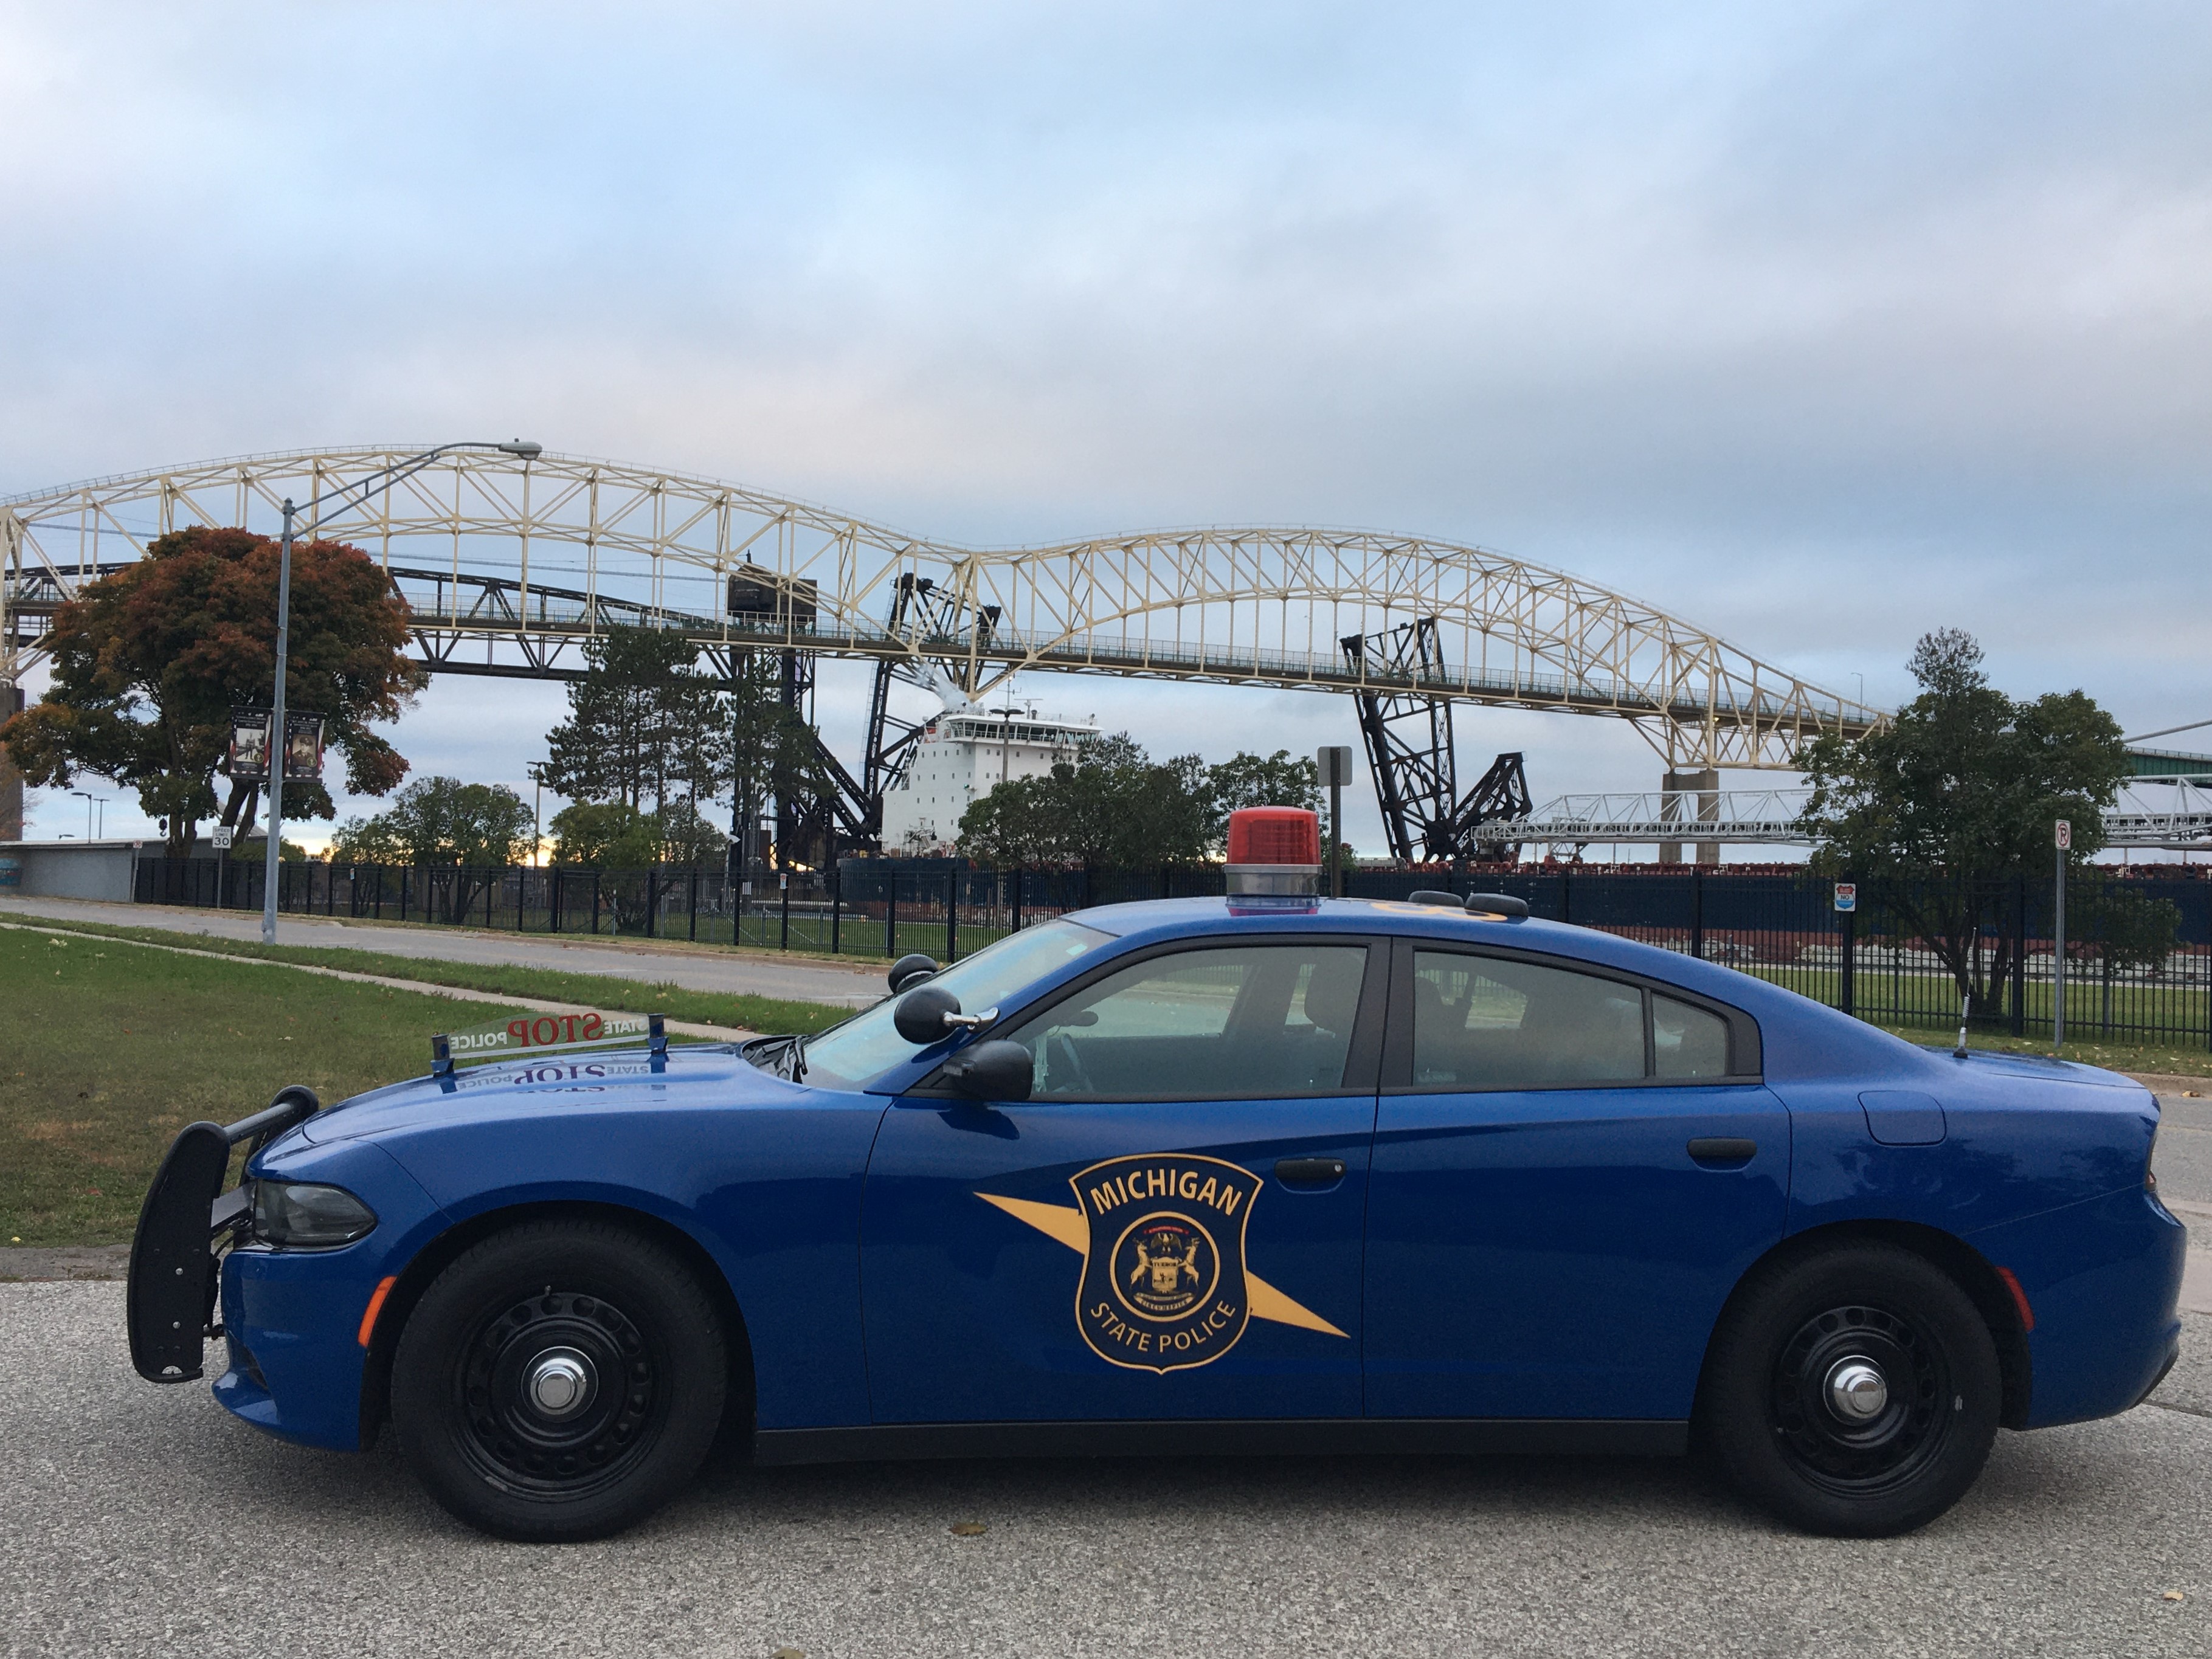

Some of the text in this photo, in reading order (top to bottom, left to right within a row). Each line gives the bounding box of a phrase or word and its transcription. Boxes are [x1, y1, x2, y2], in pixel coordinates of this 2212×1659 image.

[215, 837, 229, 846] 30
[1090, 1168, 1243, 1216] MICHIGAN
[1090, 1300, 1237, 1353] STATE POLICE
